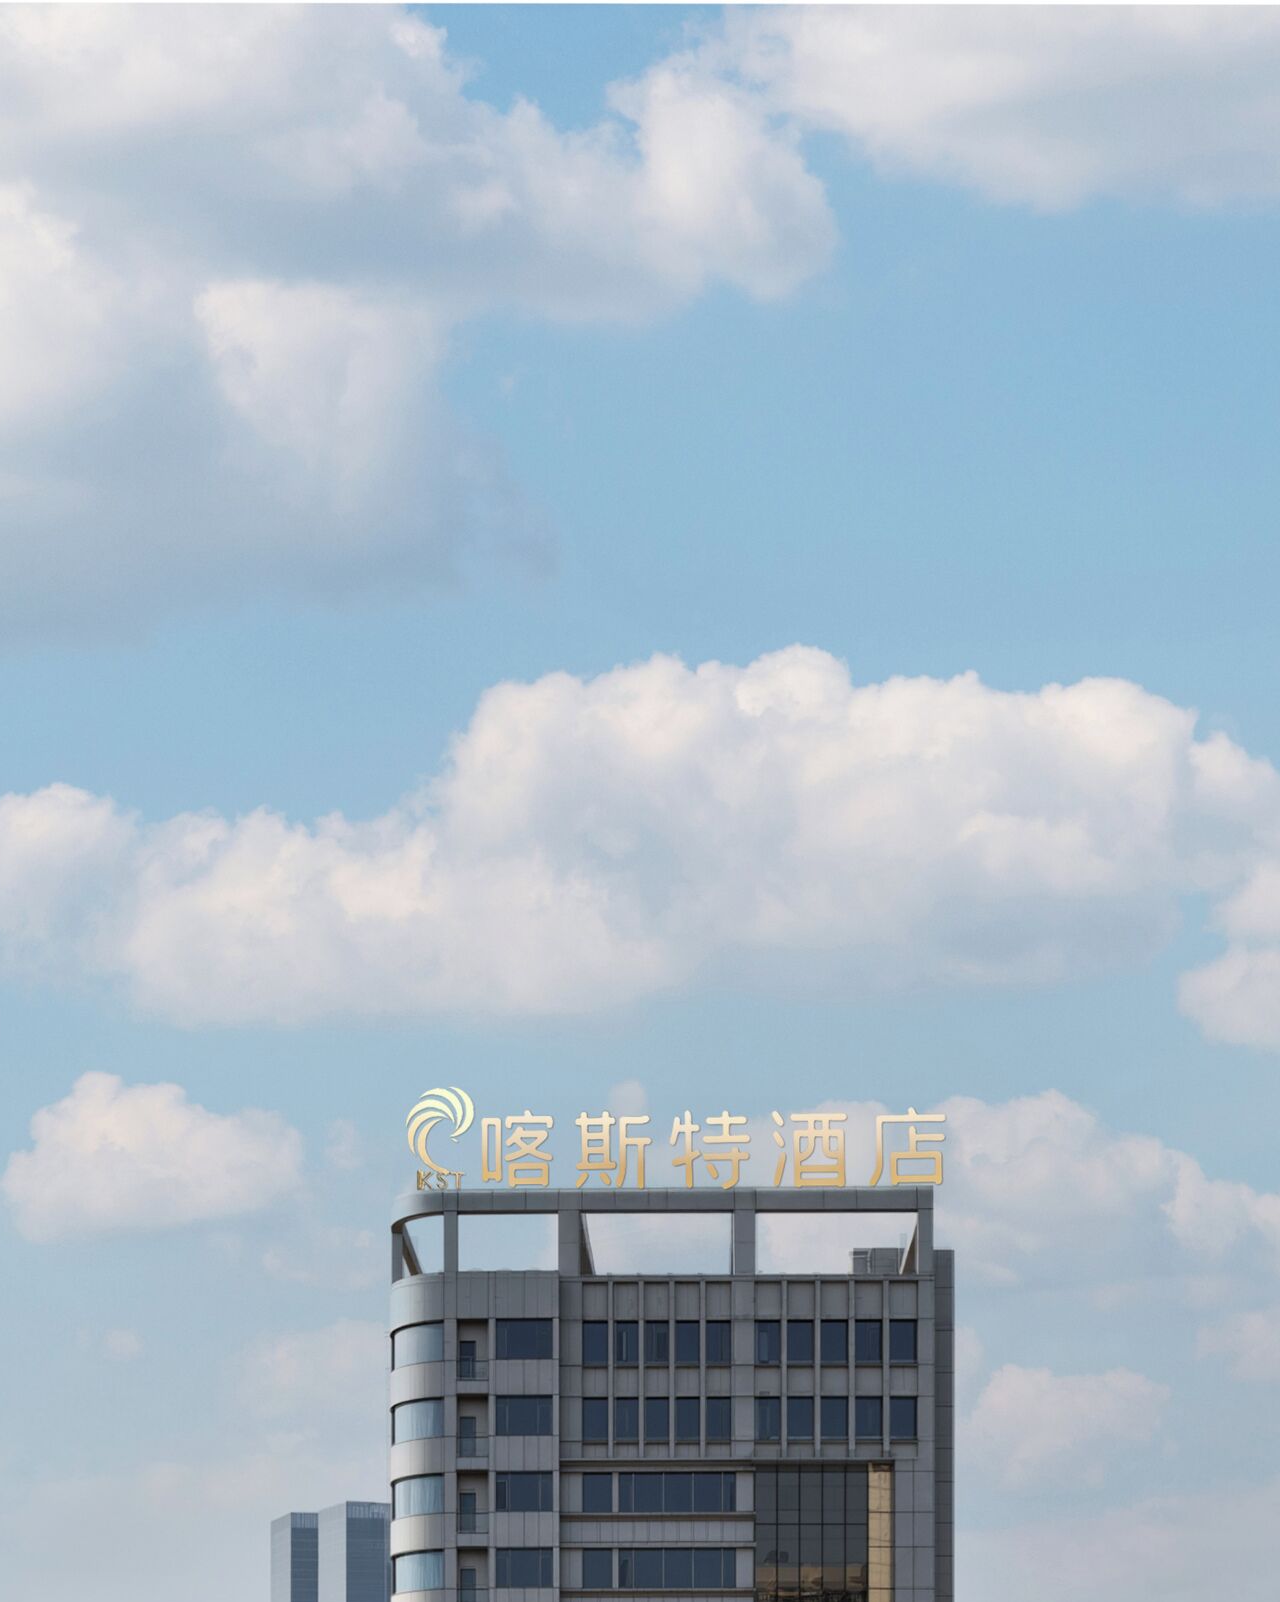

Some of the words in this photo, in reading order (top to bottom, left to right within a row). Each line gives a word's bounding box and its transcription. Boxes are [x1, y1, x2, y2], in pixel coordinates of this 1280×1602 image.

[481, 1107, 946, 1189] 喀斯特酒店
[416, 1168, 465, 1191] KST
